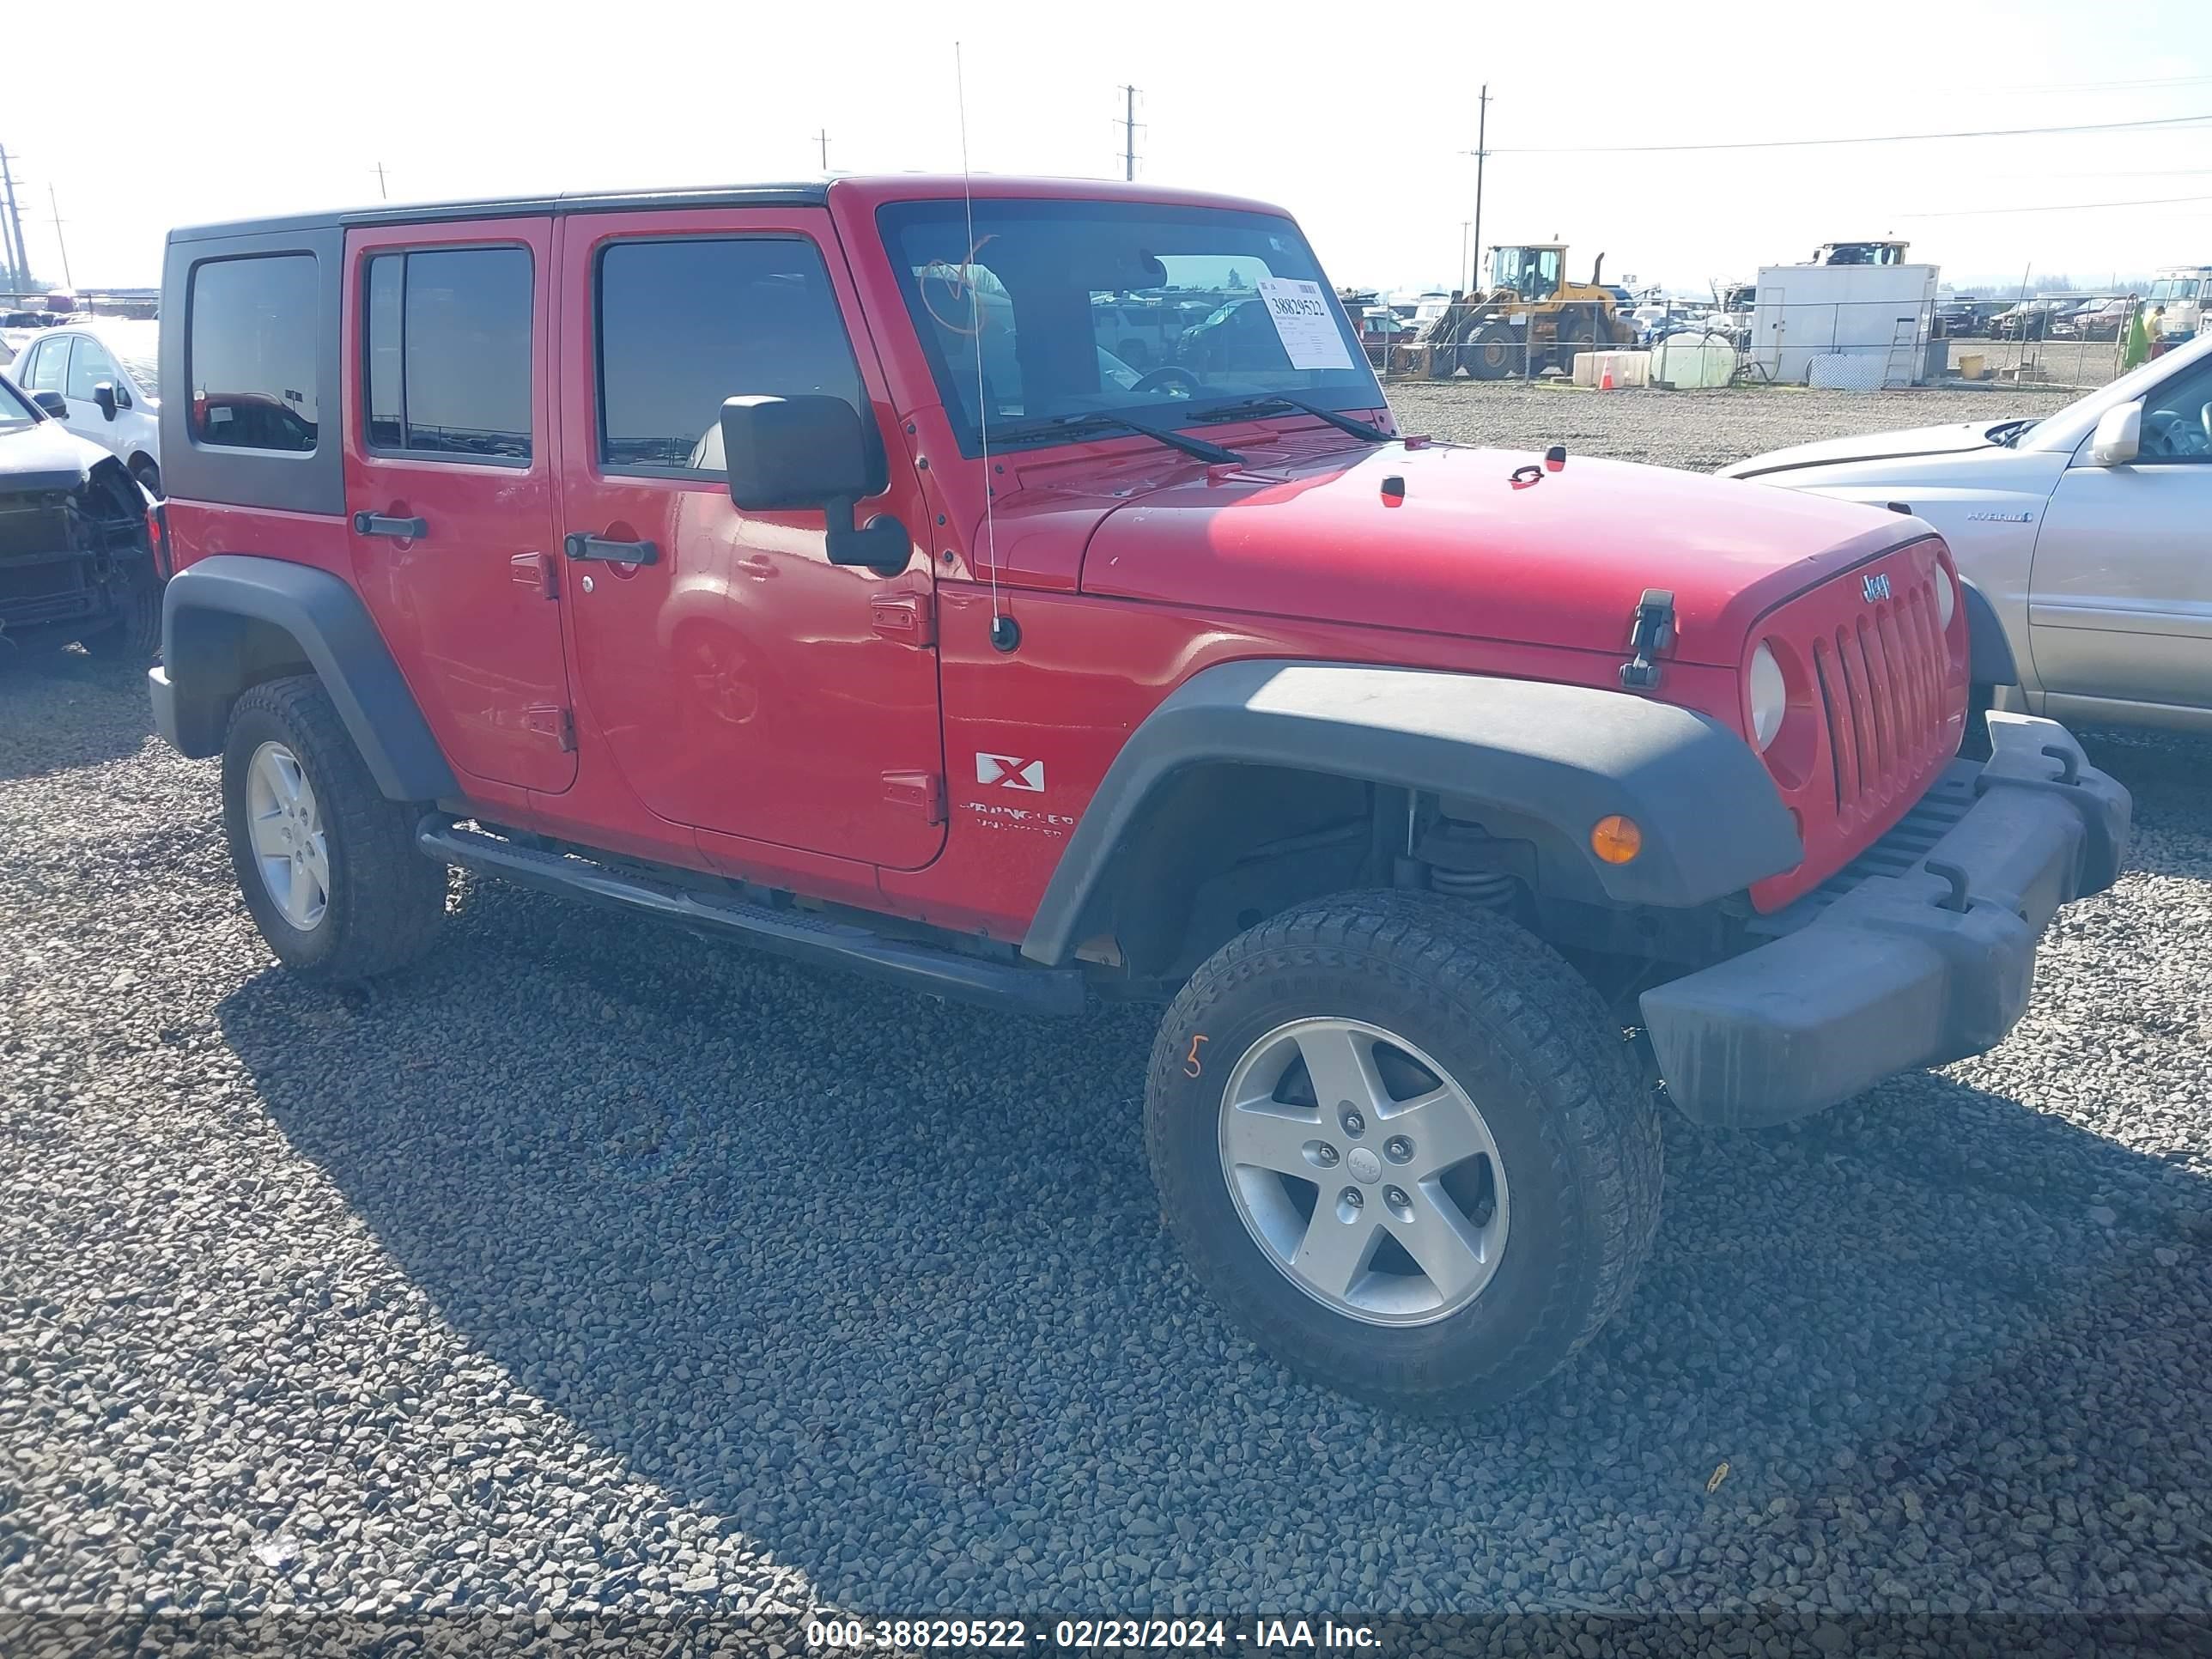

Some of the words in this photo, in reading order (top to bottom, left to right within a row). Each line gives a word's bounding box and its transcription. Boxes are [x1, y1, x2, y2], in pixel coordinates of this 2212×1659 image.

[1271, 297, 1325, 316] 38829522
[1966, 512, 2022, 522] HYBRID
[1862, 574, 1891, 603] Jeep
[985, 754, 1043, 789] X
[1182, 1035, 1210, 1079] 5
